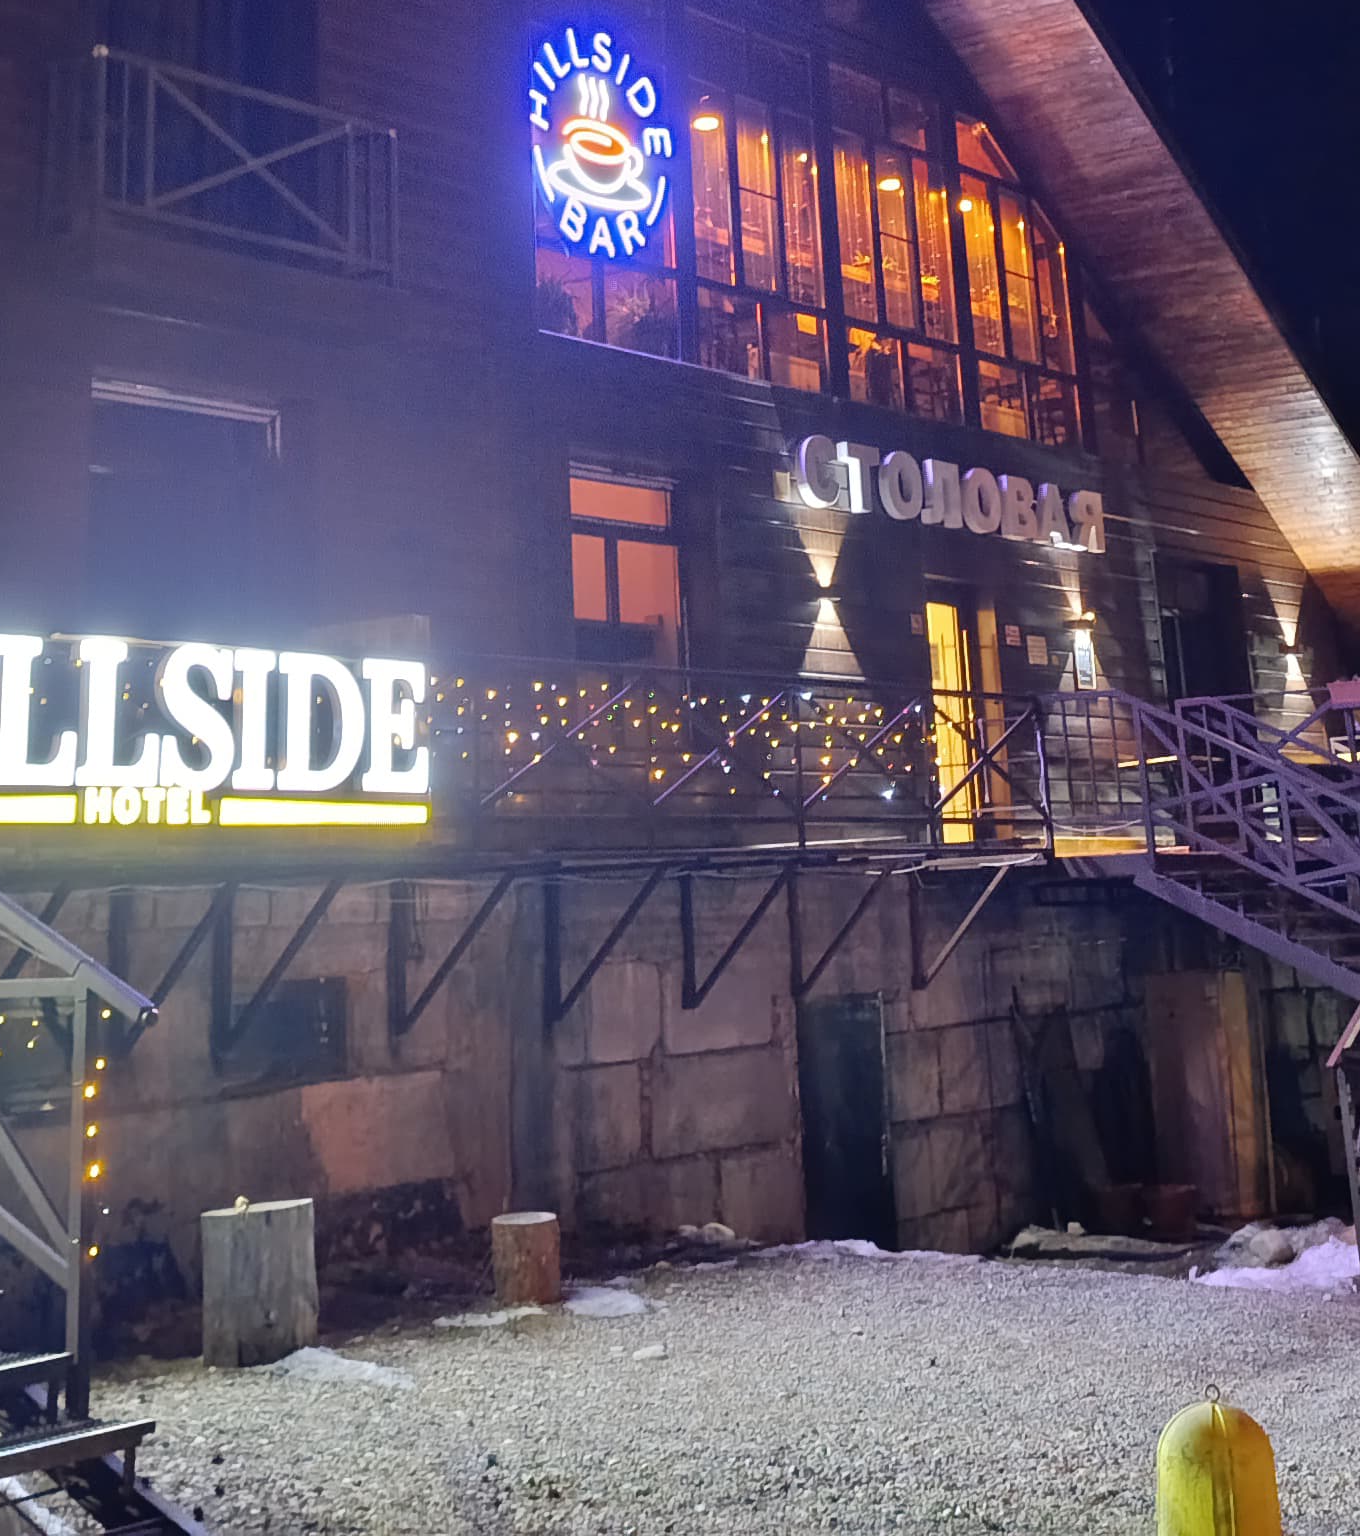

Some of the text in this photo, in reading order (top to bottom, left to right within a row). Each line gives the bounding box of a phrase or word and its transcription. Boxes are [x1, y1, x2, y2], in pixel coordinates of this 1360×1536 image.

[529, 27, 673, 158] HILLSIDE
[559, 197, 646, 259] BAR
[796, 434, 1106, 554] СТОЛОВАЯ
[83, 785, 212, 825] HOTEL
